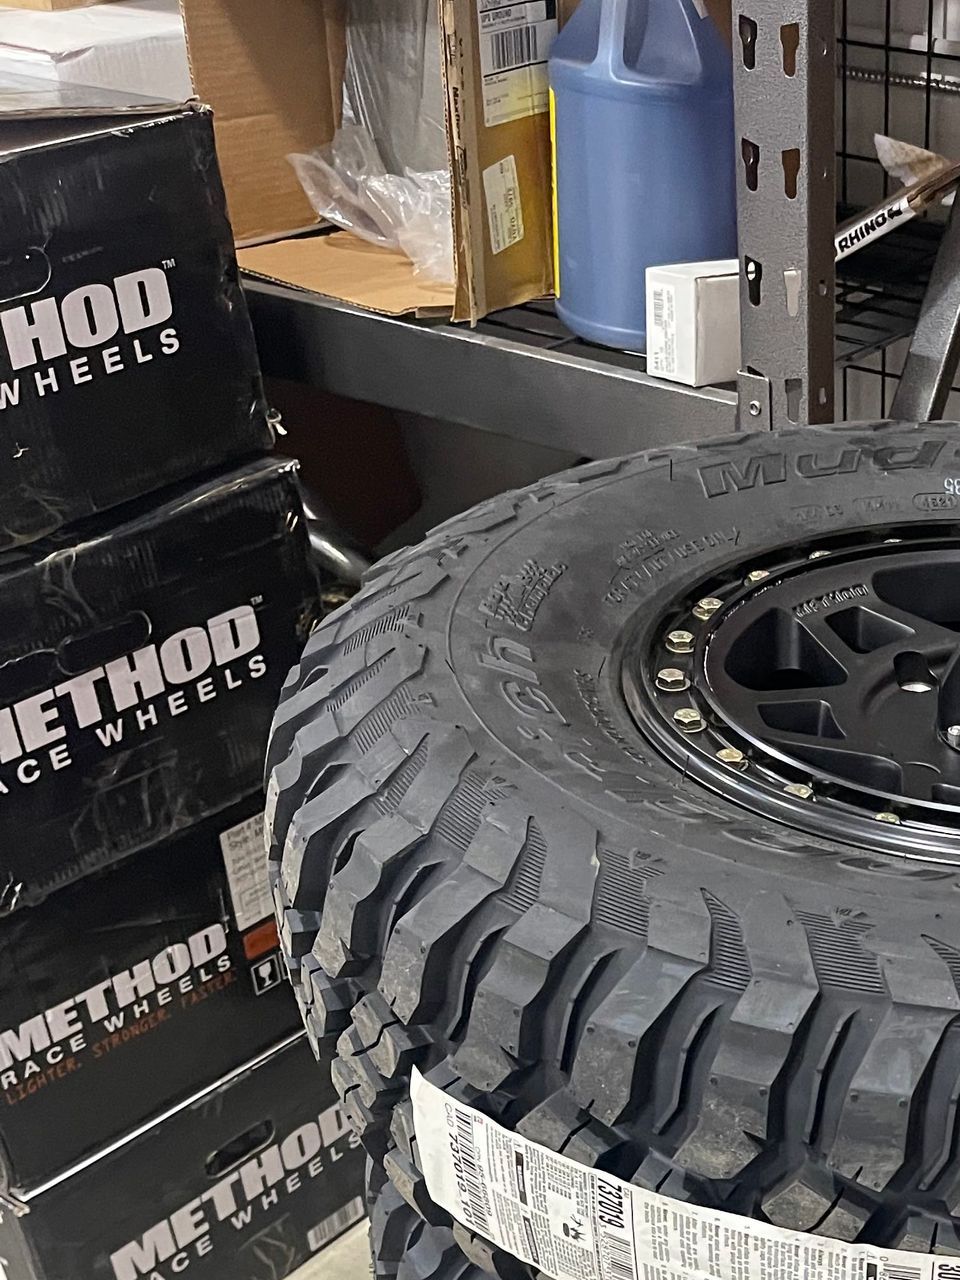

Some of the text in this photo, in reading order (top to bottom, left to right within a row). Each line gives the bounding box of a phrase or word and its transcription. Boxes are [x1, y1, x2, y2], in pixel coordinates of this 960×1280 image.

[838, 213, 887, 252] RHINO
[95, 654, 267, 748] WHEELS
[0, 923, 228, 1068] METHOD
[1, 954, 232, 1089] RACE WHEELS
[230, 1133, 361, 1231] WHEELS
[597, 1178, 625, 1229] 737019
